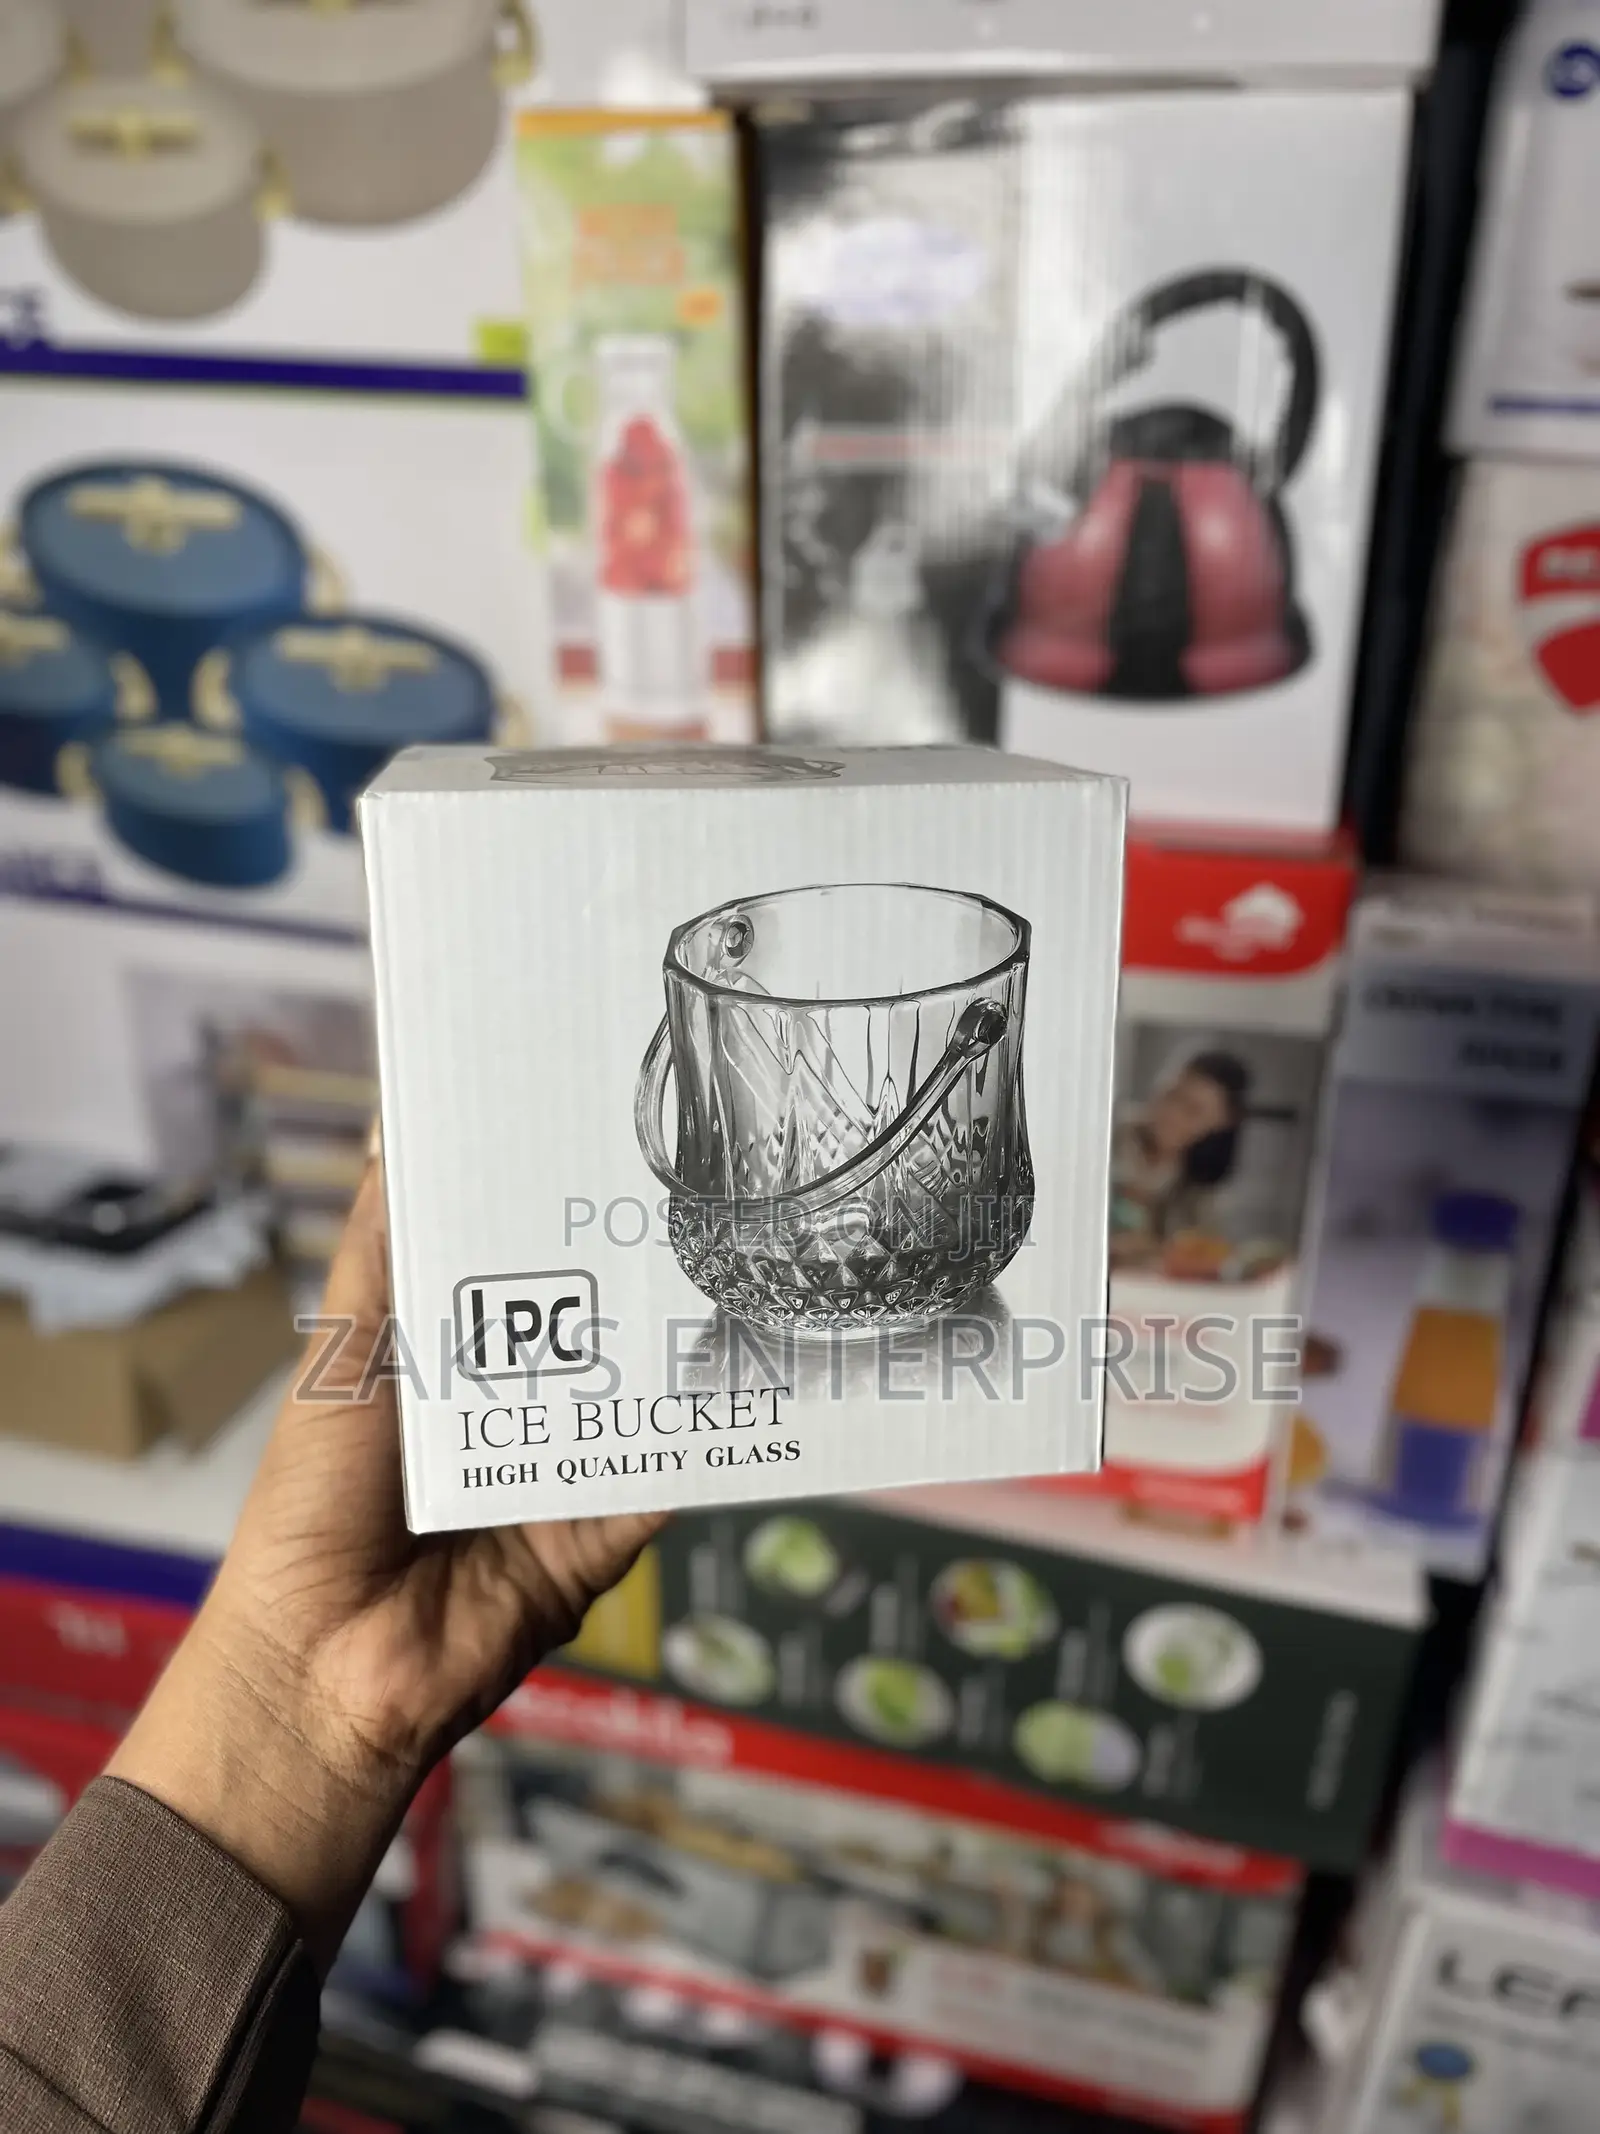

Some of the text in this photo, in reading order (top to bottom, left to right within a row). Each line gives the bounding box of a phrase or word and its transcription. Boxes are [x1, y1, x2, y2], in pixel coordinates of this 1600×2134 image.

[458, 1387, 791, 1450] ICE BUCKET
[462, 1440, 801, 1488] HIGH QUALITY GLASS
